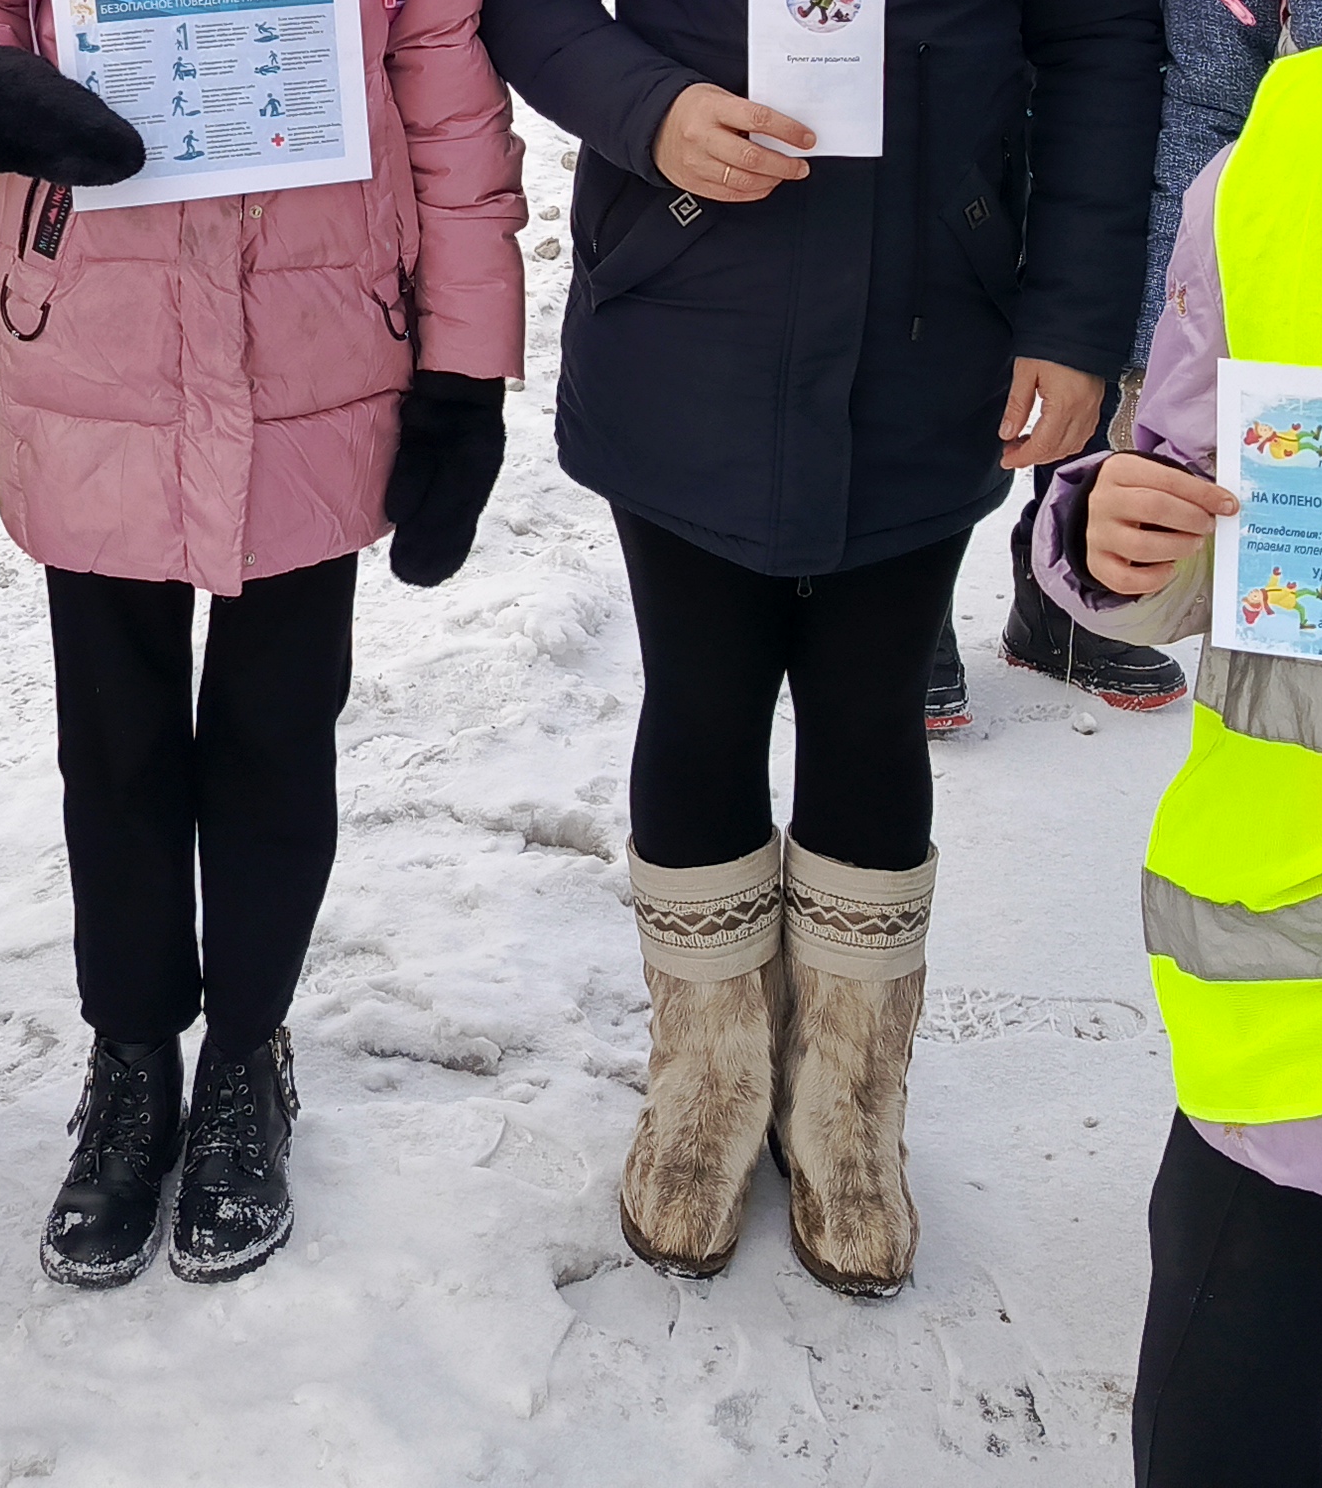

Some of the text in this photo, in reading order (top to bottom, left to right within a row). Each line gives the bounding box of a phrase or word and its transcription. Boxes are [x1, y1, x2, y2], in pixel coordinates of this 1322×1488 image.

[1251, 491, 1322, 508] НА КОЛЕНО
[1247, 523, 1322, 540] Последствия:
[1246, 540, 1292, 553] травма
